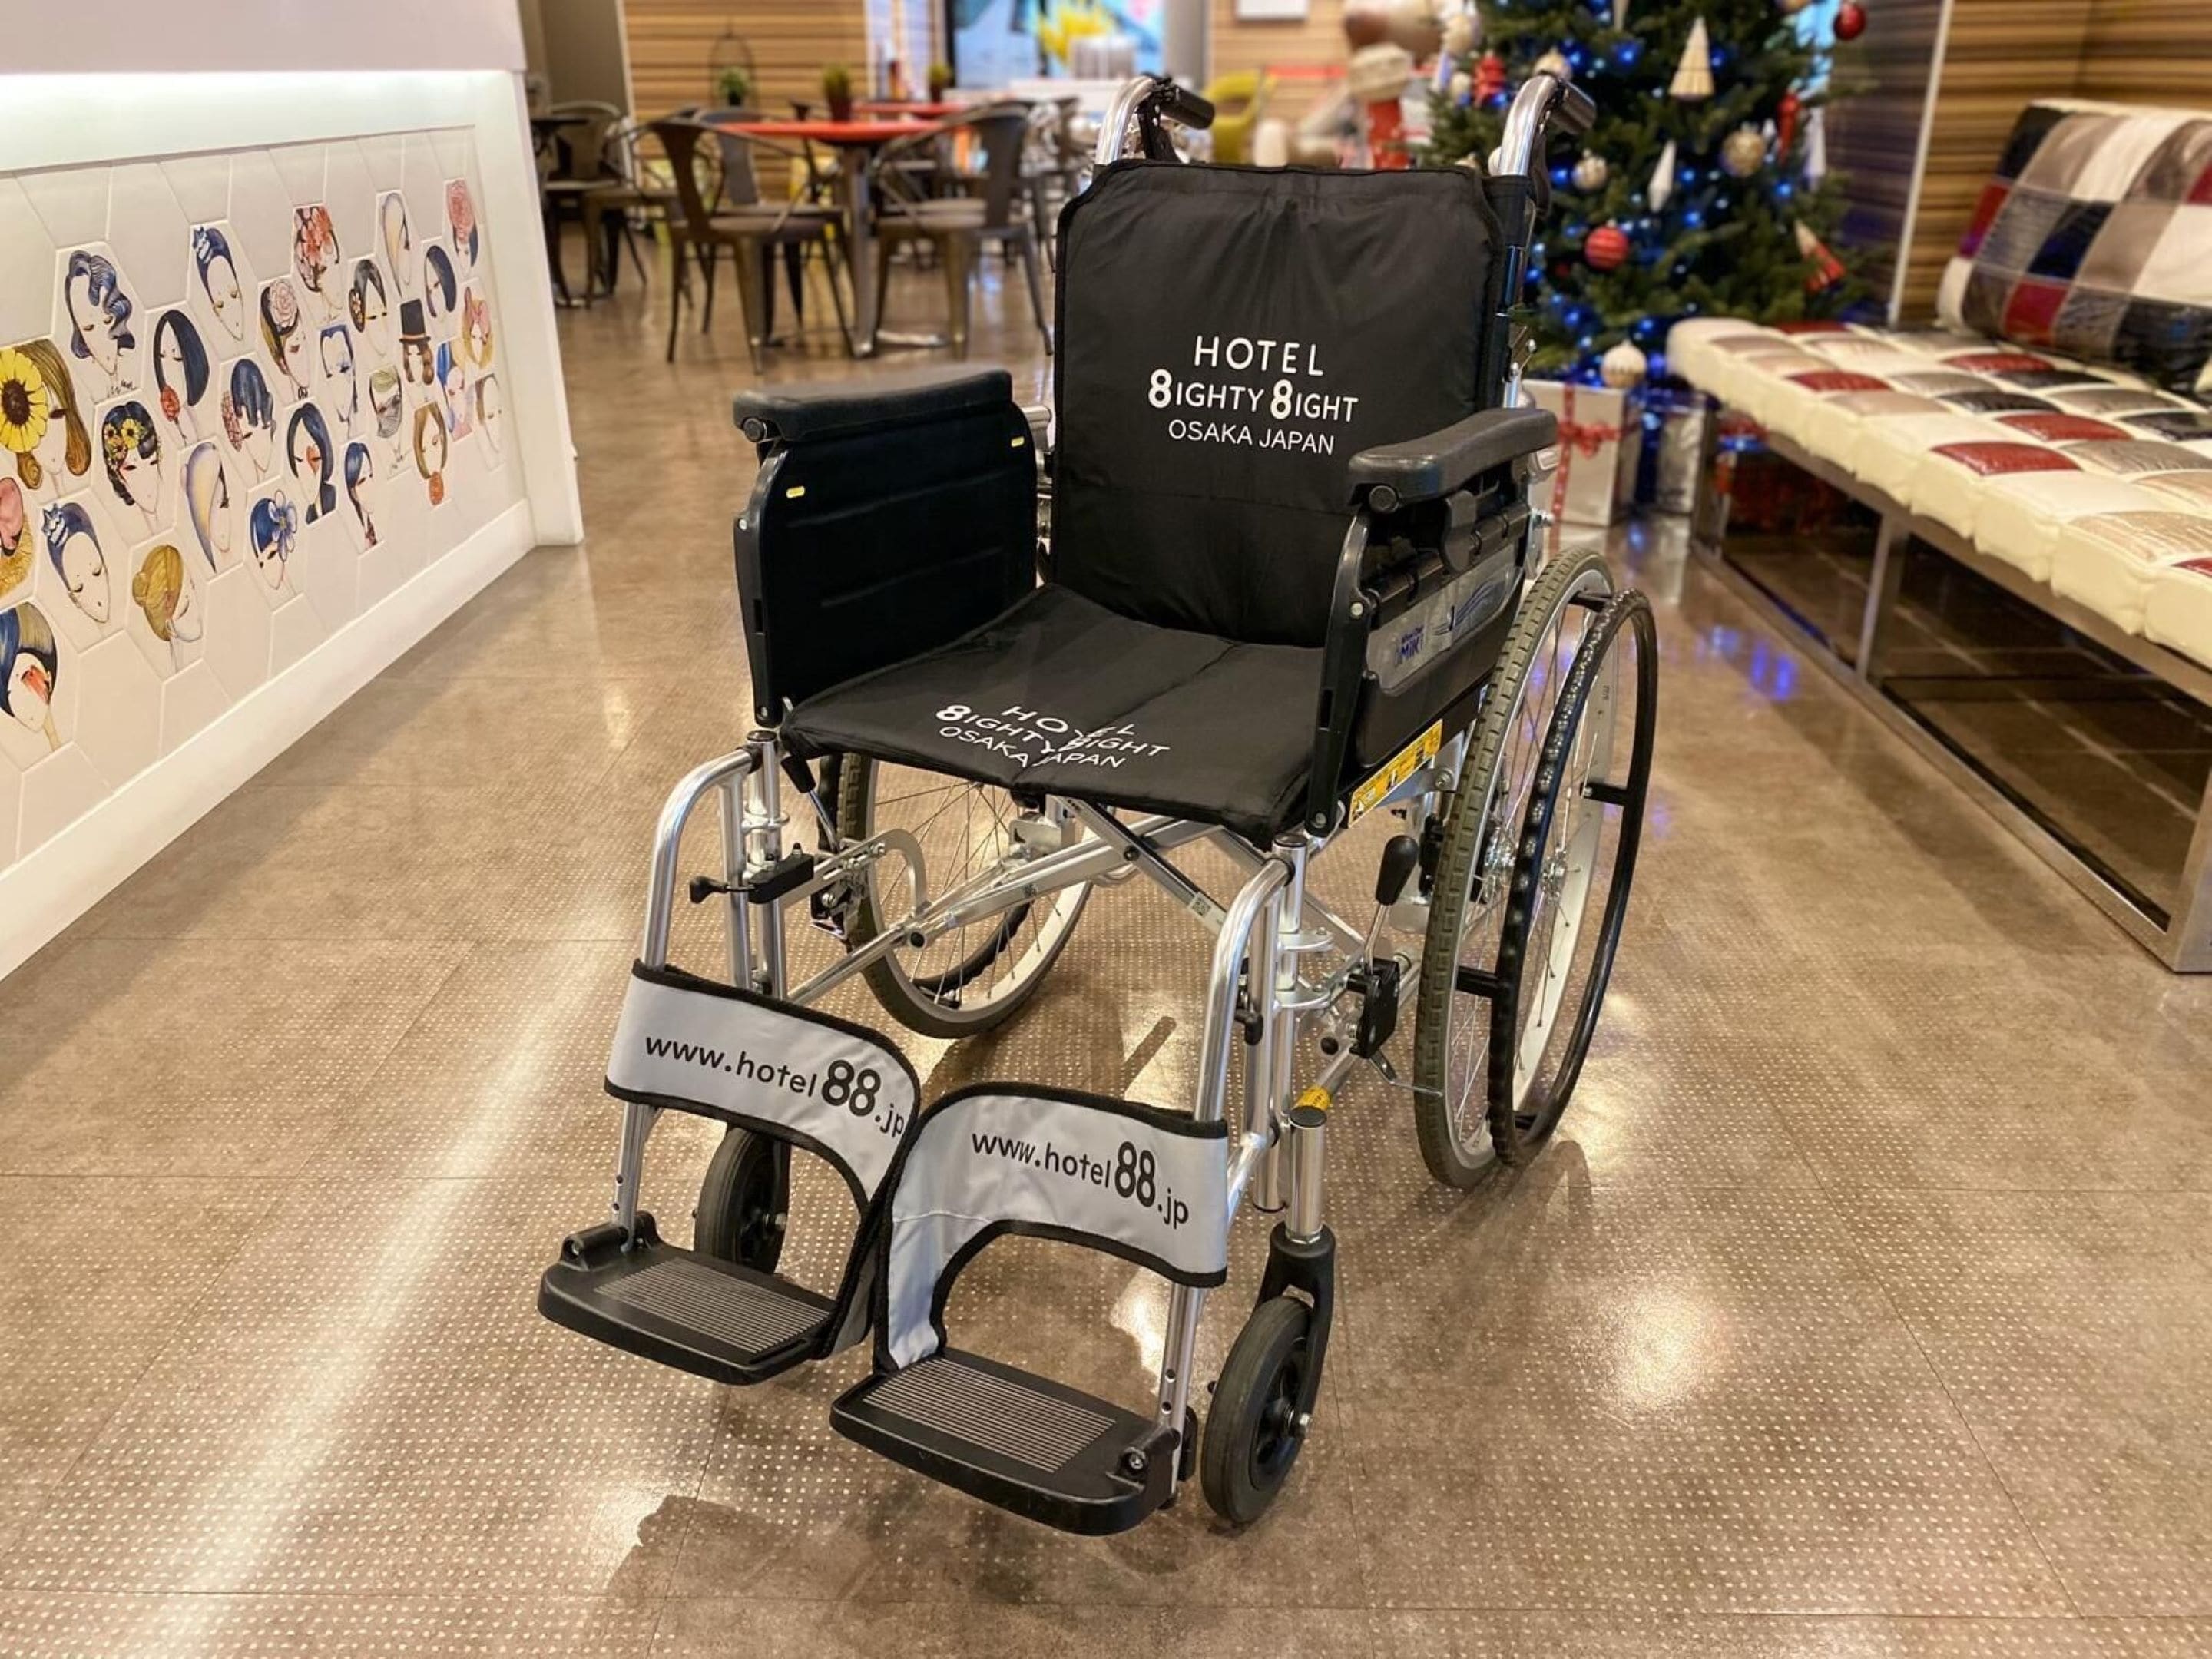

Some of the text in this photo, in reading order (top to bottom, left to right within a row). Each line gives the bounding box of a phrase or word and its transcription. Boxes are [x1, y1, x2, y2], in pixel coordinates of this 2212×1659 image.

[1194, 335, 1323, 376] HOTEL
[1168, 419, 1334, 455] OSAKA JAPAN
[939, 726, 1029, 768] OSAKA
[645, 1035, 905, 1137] www.hotel88.jp
[972, 1132, 1189, 1229] www.hotel88.jp
